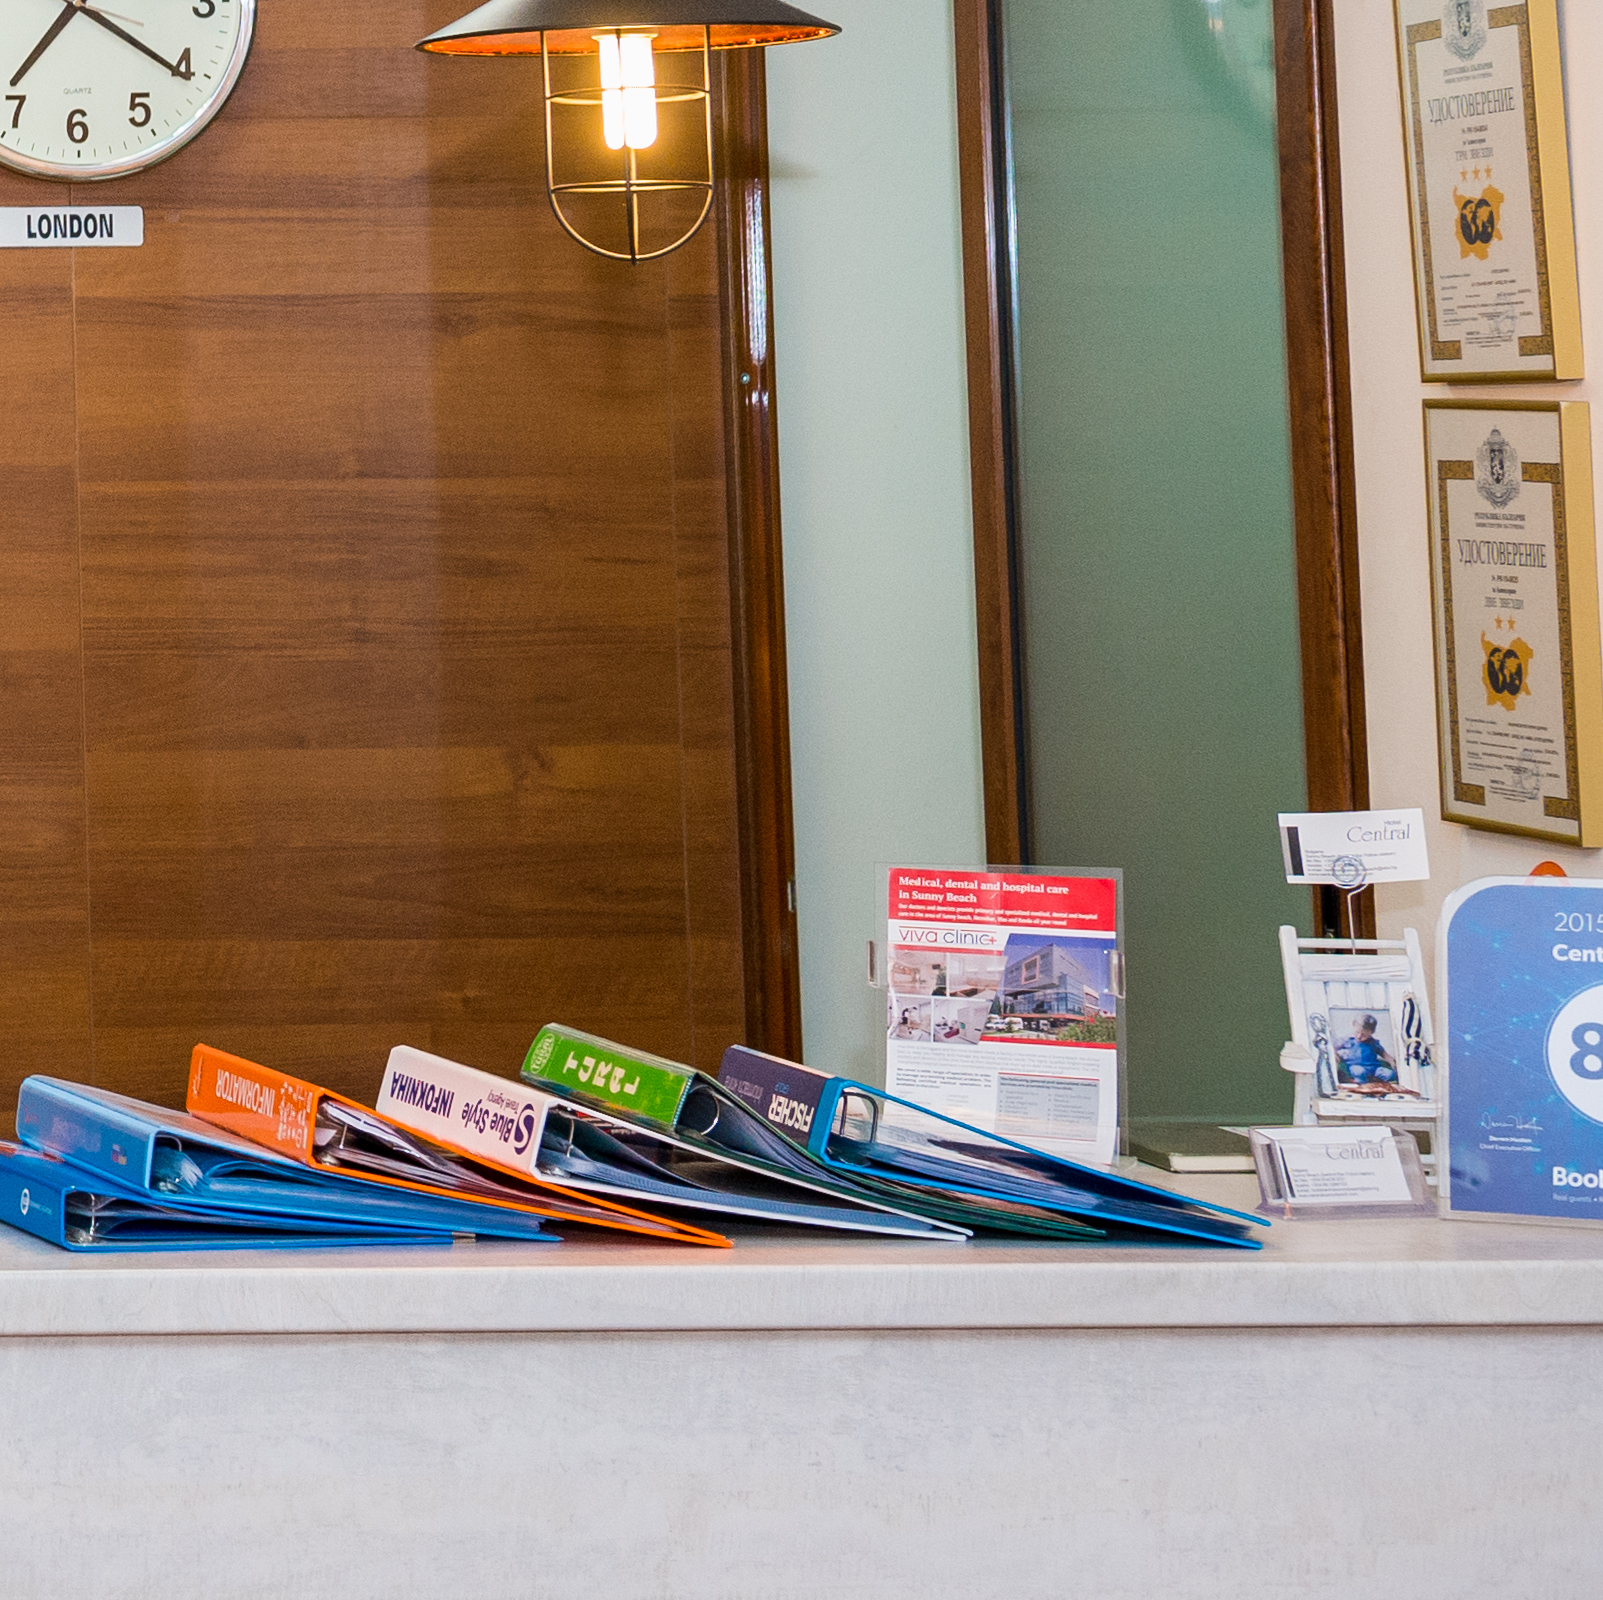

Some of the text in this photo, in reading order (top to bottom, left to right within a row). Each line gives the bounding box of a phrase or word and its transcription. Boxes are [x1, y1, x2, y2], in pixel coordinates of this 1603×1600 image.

[172, 47, 196, 78] 4
[63, 87, 92, 95] QUARTZ
[1427, 86, 1515, 126] УДОСТОВЕРЕНИЕ
[5, 94, 27, 129] 7
[66, 109, 90, 144] 6
[128, 92, 152, 128] 5
[26, 213, 114, 239] LONDON
[1457, 538, 1547, 568] УДОСТОВЕРЕНИЕ
[1346, 823, 1411, 843] Central
[898, 876, 1069, 895] Medical, dental and hospital care
[899, 890, 977, 904] in Sunny Beach
[214, 1068, 275, 1118] INFORMATOR
[389, 1071, 454, 1119] INFOKNIHA
[461, 1098, 515, 1143] Blue Style
[768, 1093, 815, 1133] FISCHER
